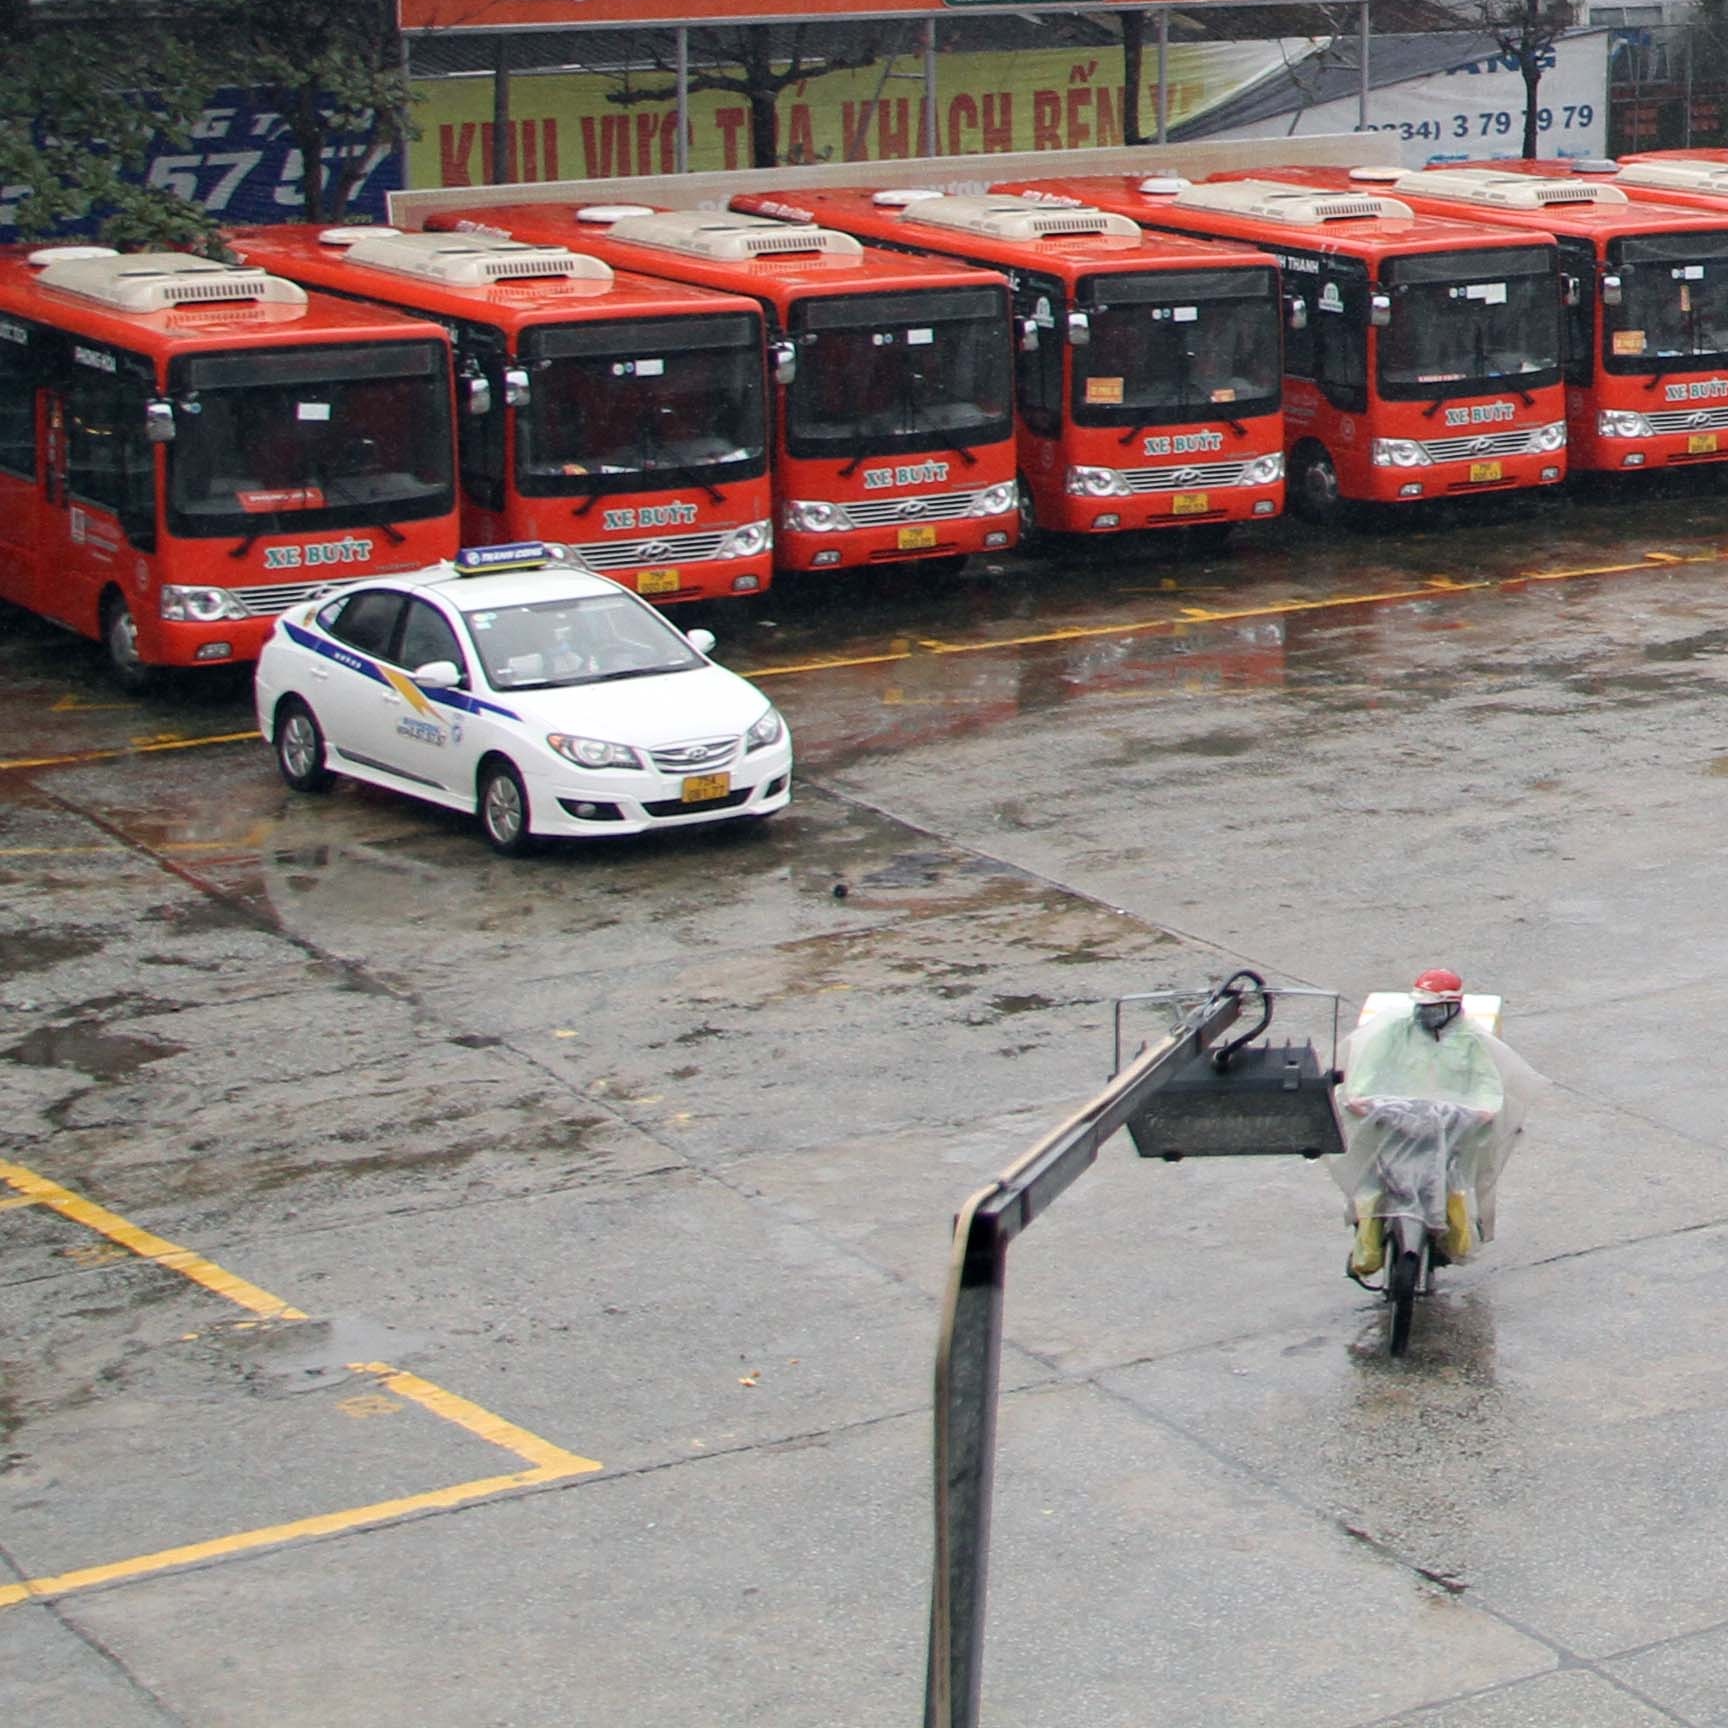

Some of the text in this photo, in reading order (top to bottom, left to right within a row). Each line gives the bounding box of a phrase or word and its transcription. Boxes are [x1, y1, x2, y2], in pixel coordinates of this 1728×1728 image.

[1452, 104, 1594, 137] 3 79 79
[1446, 408, 1469, 426] XE
[1144, 428, 1223, 455] XE BUÝT
[864, 459, 948, 489] XE BUÝT
[603, 500, 698, 531] XE BUÝT
[264, 535, 373, 569] XE BUÝT
